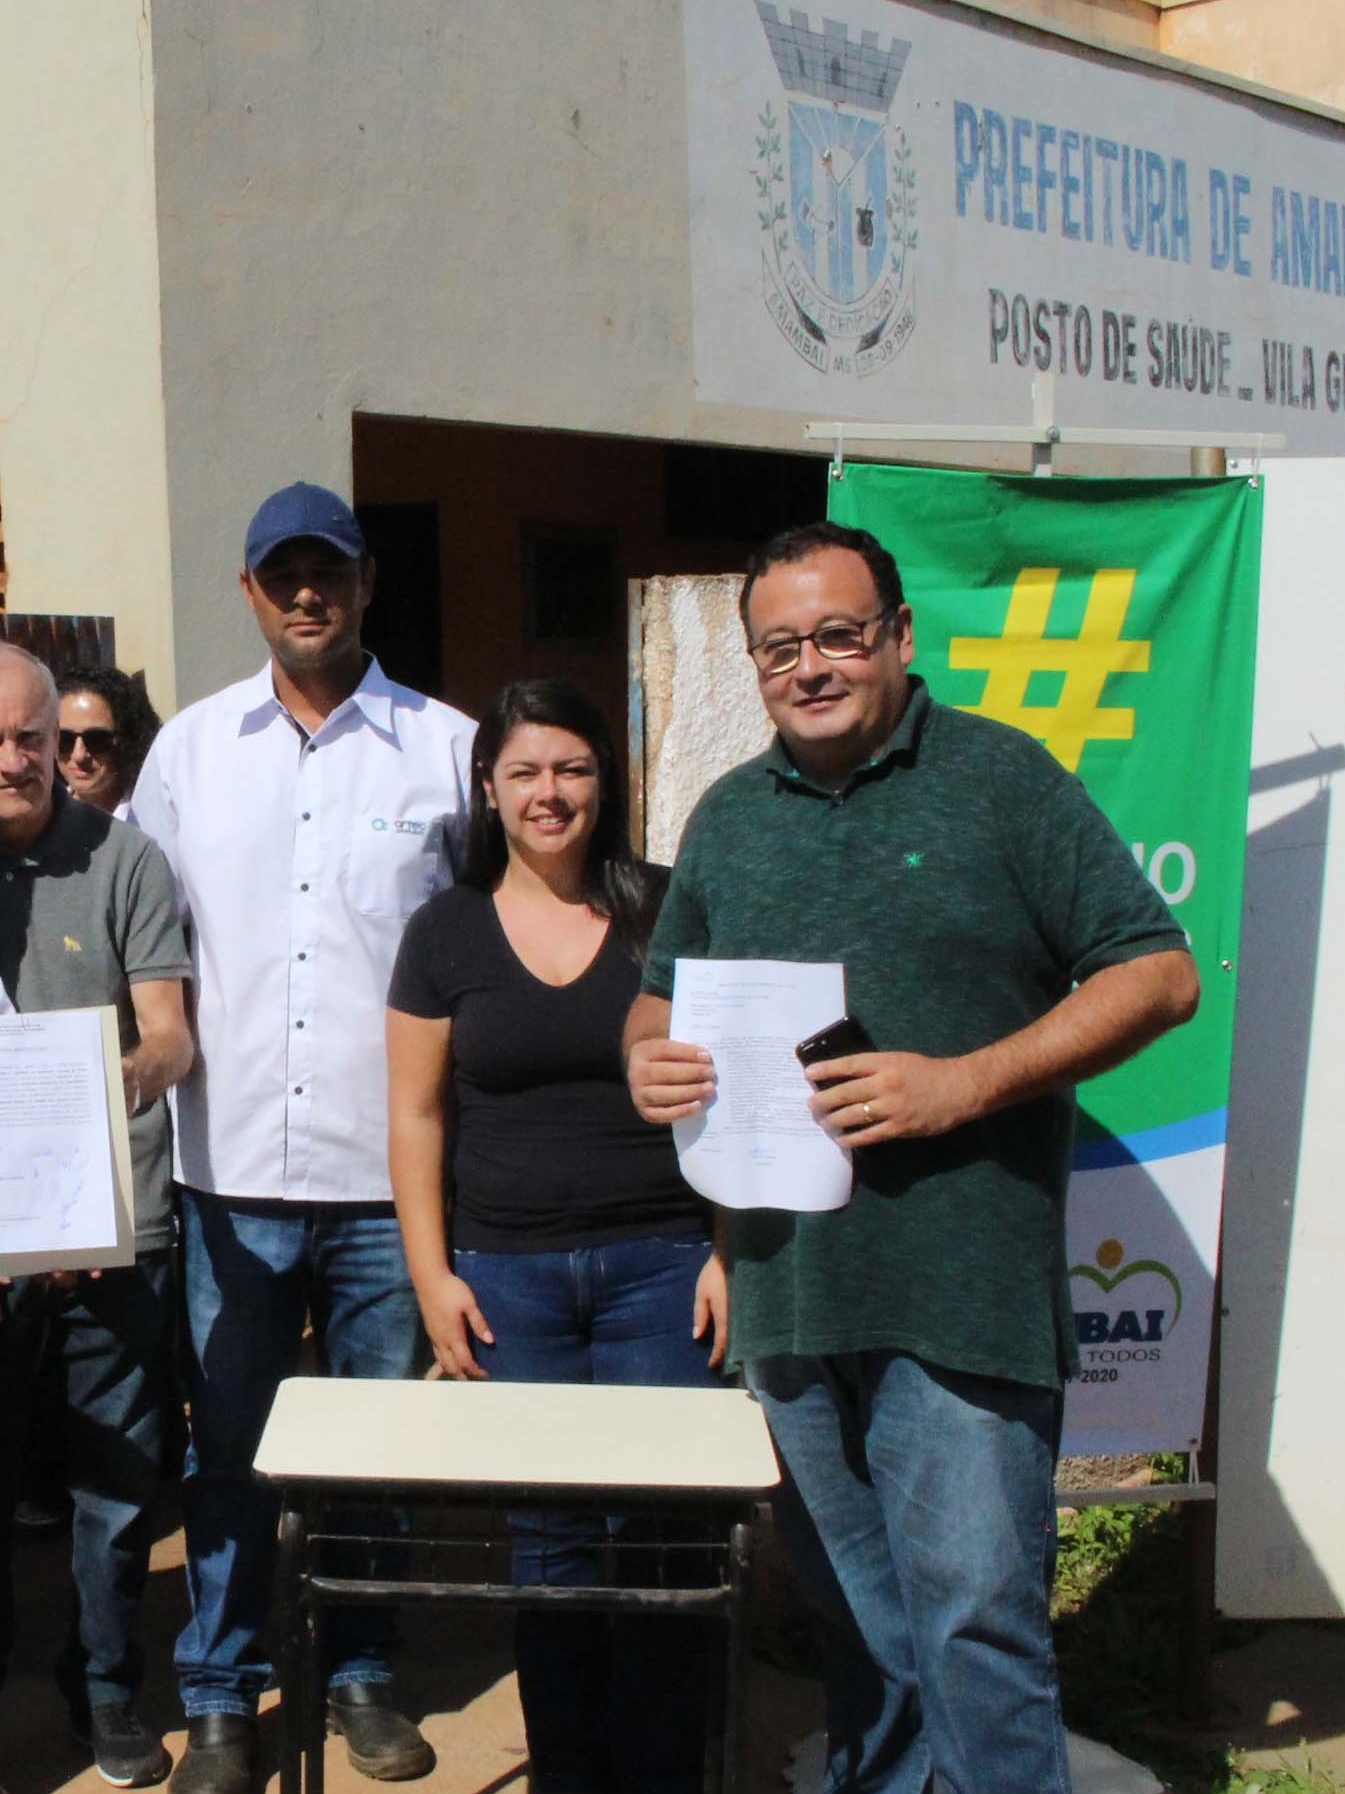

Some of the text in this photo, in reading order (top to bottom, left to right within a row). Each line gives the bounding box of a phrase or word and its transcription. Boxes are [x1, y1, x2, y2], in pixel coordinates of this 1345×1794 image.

[954, 99, 1345, 297] PREFEITURA DE AMA
[988, 288, 1092, 377] POSTO
[1102, 310, 1138, 384] DE
[1146, 314, 1232, 398] SAÚDE
[1262, 338, 1316, 412] VILA
[1324, 350, 1345, 413] G
[1087, 1348, 1161, 1363] TODOS
